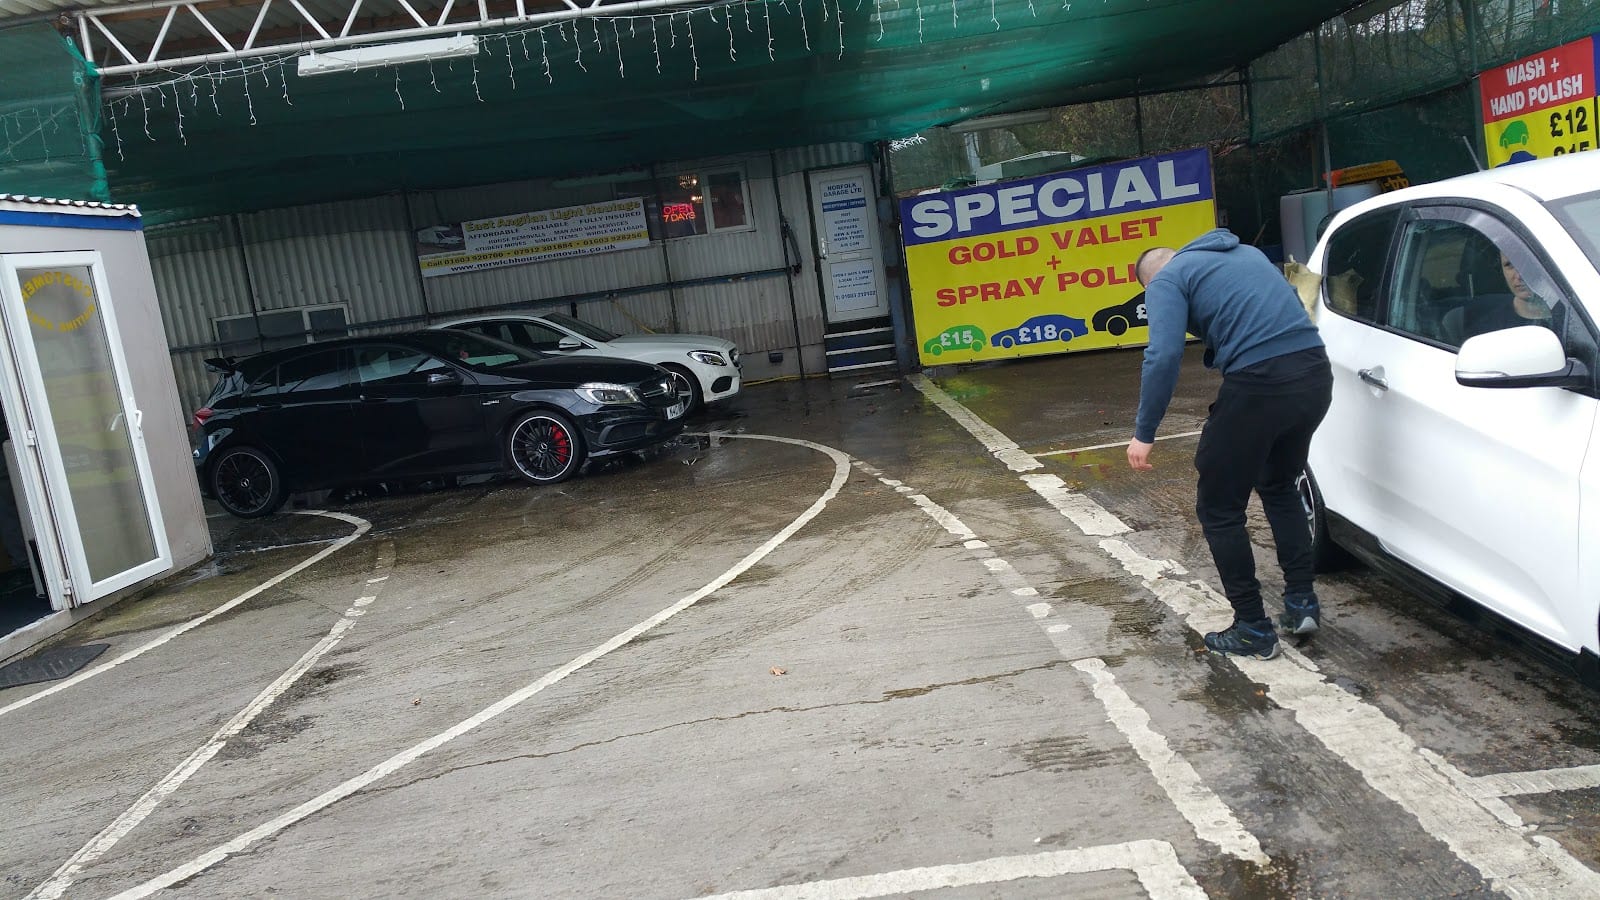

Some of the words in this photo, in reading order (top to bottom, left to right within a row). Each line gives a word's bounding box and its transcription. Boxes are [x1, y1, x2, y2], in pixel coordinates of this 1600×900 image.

[1506, 57, 1546, 86] WASH
[1550, 57, 1560, 73] +
[1490, 92, 1525, 117] HAND
[1528, 73, 1583, 107] POLISH
[1549, 106, 1588, 138] £12
[828, 183, 857, 191] NORFOLK
[663, 203, 694, 214] OPEN
[911, 159, 1200, 239] SPECIAL
[465, 221, 496, 232] East
[468, 228, 519, 240] AFFORDABLE
[530, 221, 569, 231] RELIABLE
[579, 216, 605, 225] FULLY
[605, 211, 641, 220] INSURED
[663, 214, 669, 222] 7
[670, 211, 696, 222] DAYS
[512, 232, 546, 241] REMOVALS
[554, 227, 569, 235] MAN
[598, 220, 629, 229] SERVICES
[948, 236, 1039, 265] GOLD
[1051, 216, 1163, 250] VALET
[427, 259, 443, 267] Call
[444, 256, 470, 265] 01603
[1046, 255, 1062, 270] +
[936, 275, 1045, 307] SPRAY
[1057, 263, 1138, 292] POLI
[940, 328, 974, 347] £15
[1018, 323, 1058, 342] £18
